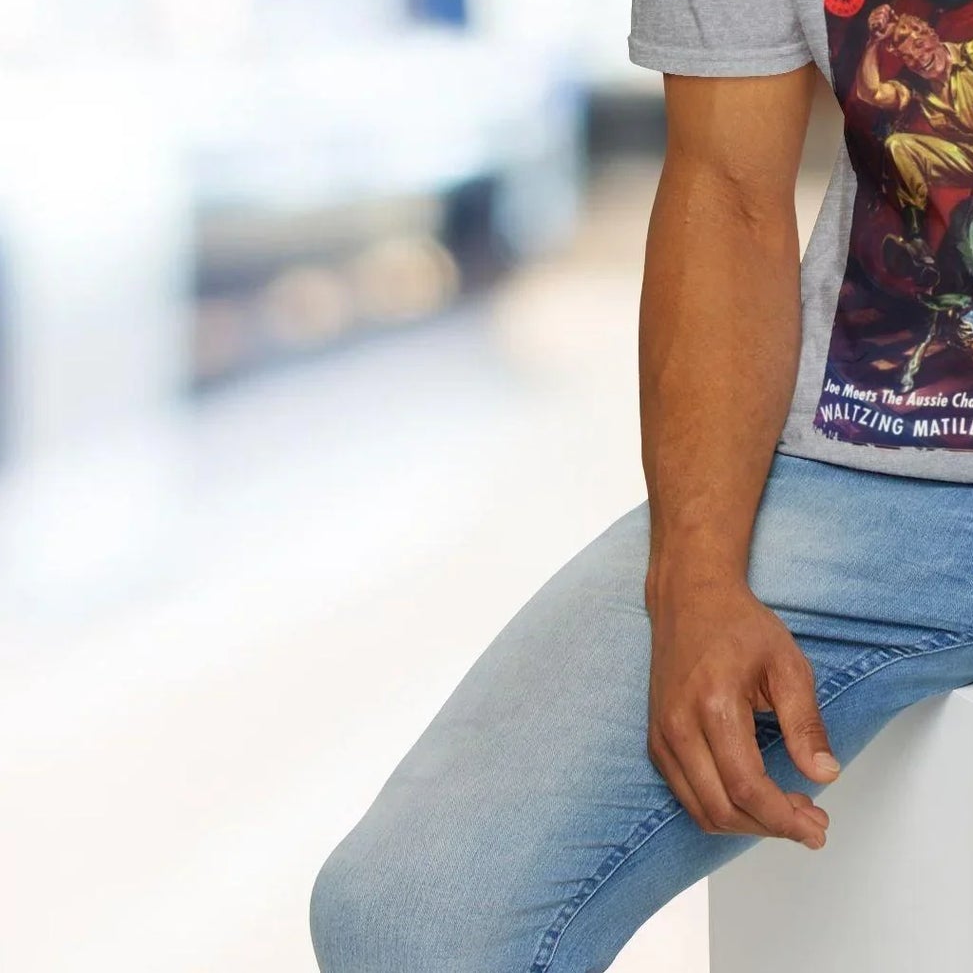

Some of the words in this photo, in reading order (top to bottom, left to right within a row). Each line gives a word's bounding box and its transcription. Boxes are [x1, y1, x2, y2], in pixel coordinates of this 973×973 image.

[823, 378, 841, 396] Joe
[841, 383, 878, 403] Meets
[881, 389, 902, 406] The
[905, 391, 949, 408] Aussie
[819, 402, 905, 436] WALTZING
